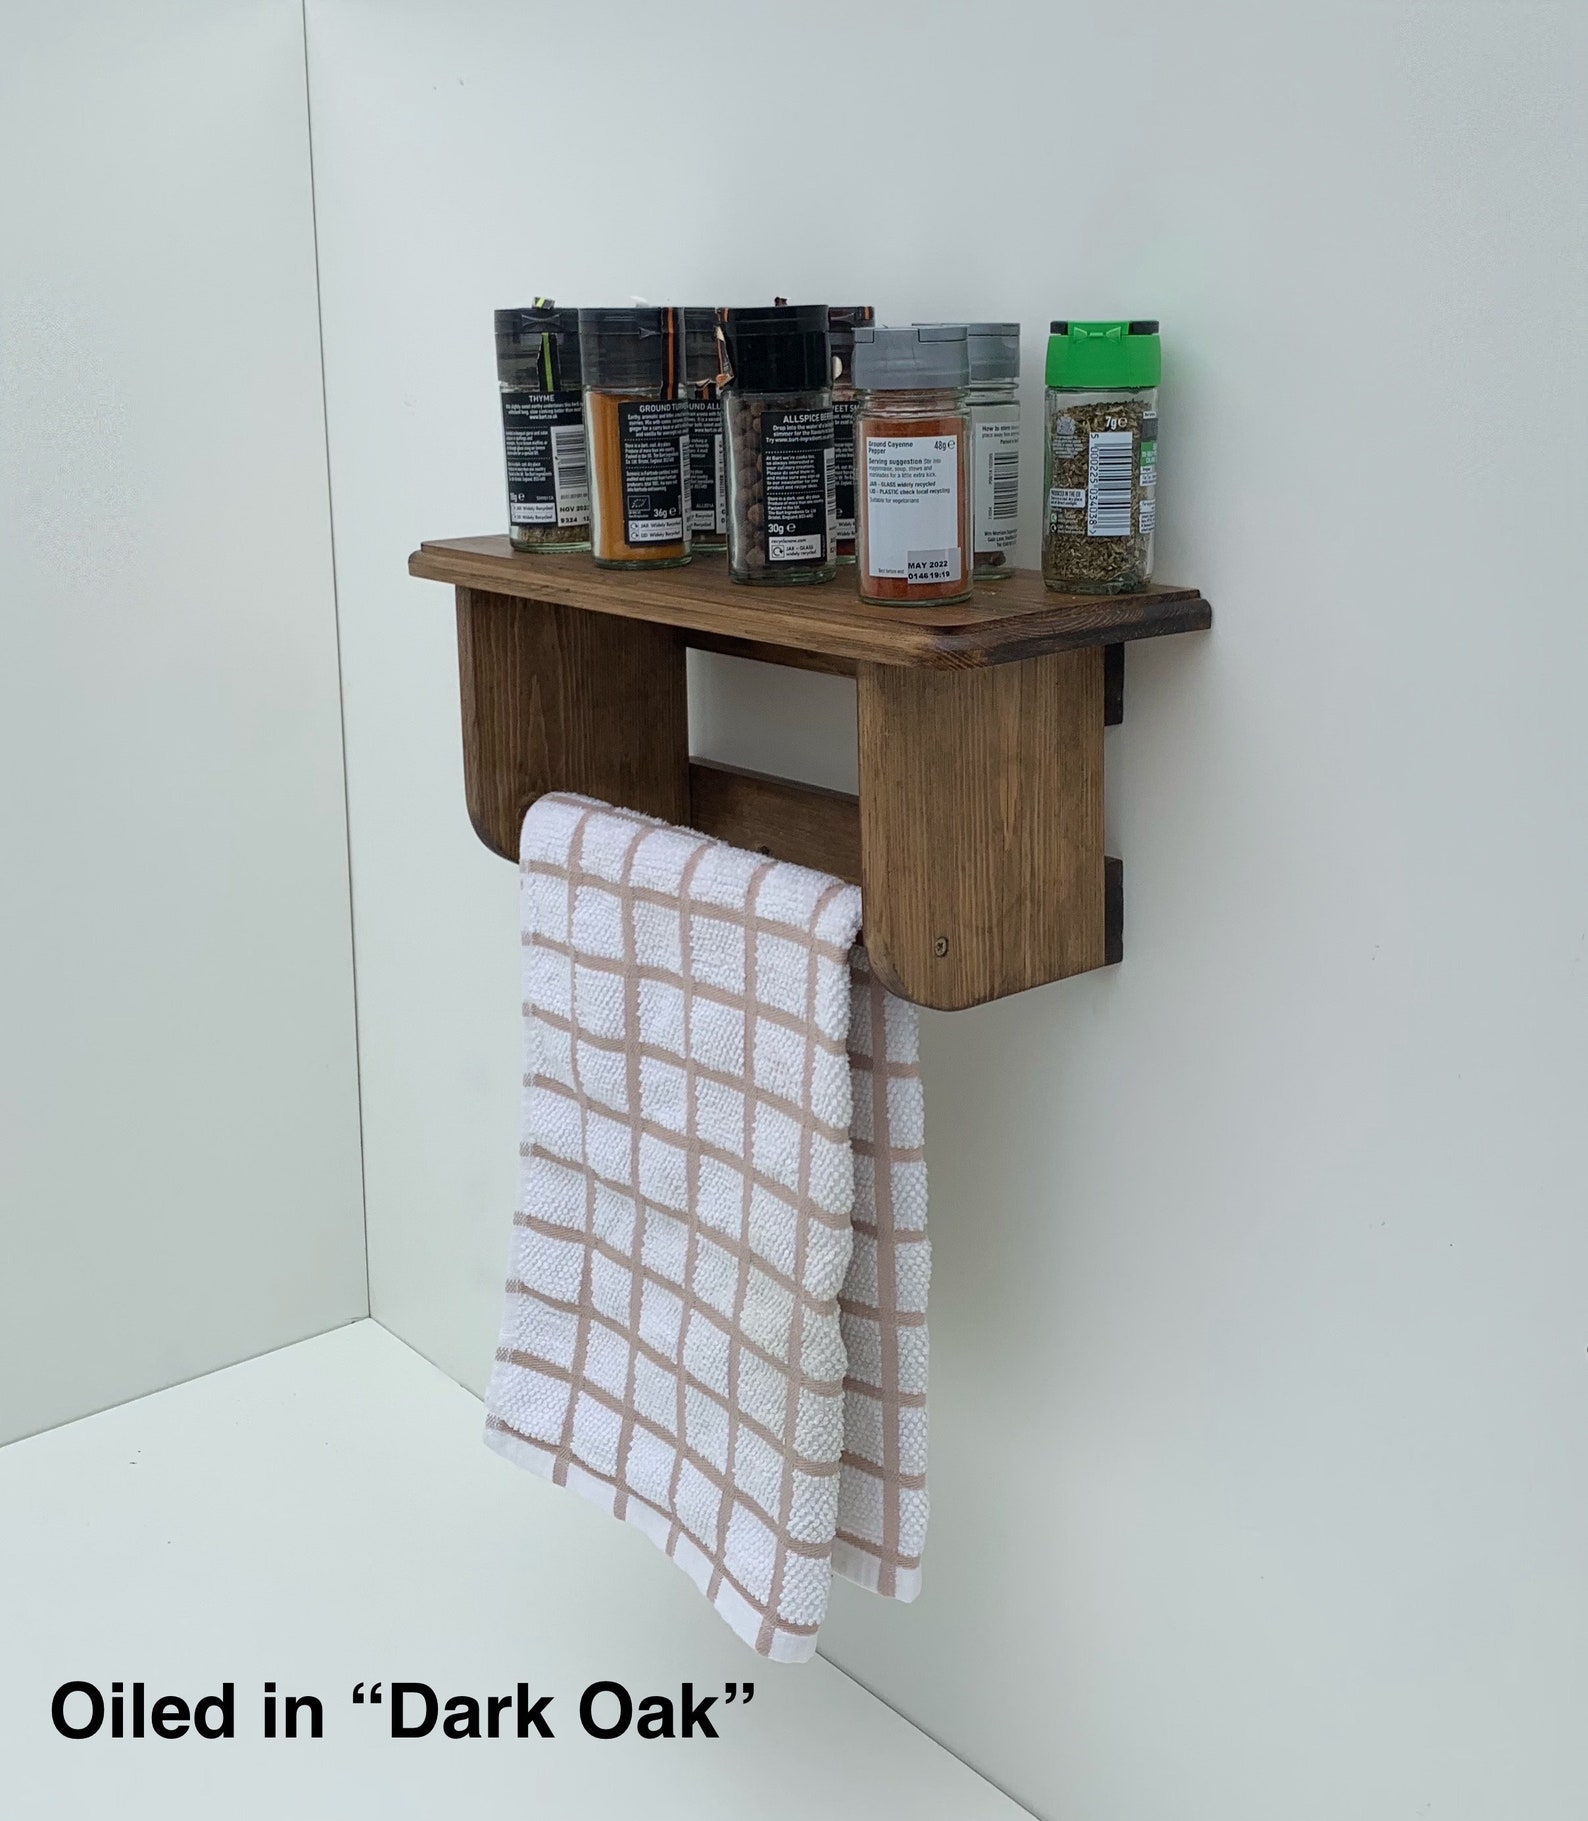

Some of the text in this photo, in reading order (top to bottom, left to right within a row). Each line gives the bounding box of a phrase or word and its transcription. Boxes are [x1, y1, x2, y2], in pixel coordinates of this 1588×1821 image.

[640, 404, 671, 413] GROUND
[783, 414, 820, 423] ALLSPICE
[1105, 416, 1117, 429] 7g
[888, 441, 913, 449] Cayenne
[934, 441, 947, 452] 48g
[869, 458, 888, 466] Serving
[889, 458, 923, 466] suggestion
[1090, 447, 1099, 484] 000225
[1090, 489, 1098, 525] 034038
[653, 509, 668, 518] 36g
[768, 524, 784, 535] 30g
[908, 571, 950, 580] 0146 19:19
